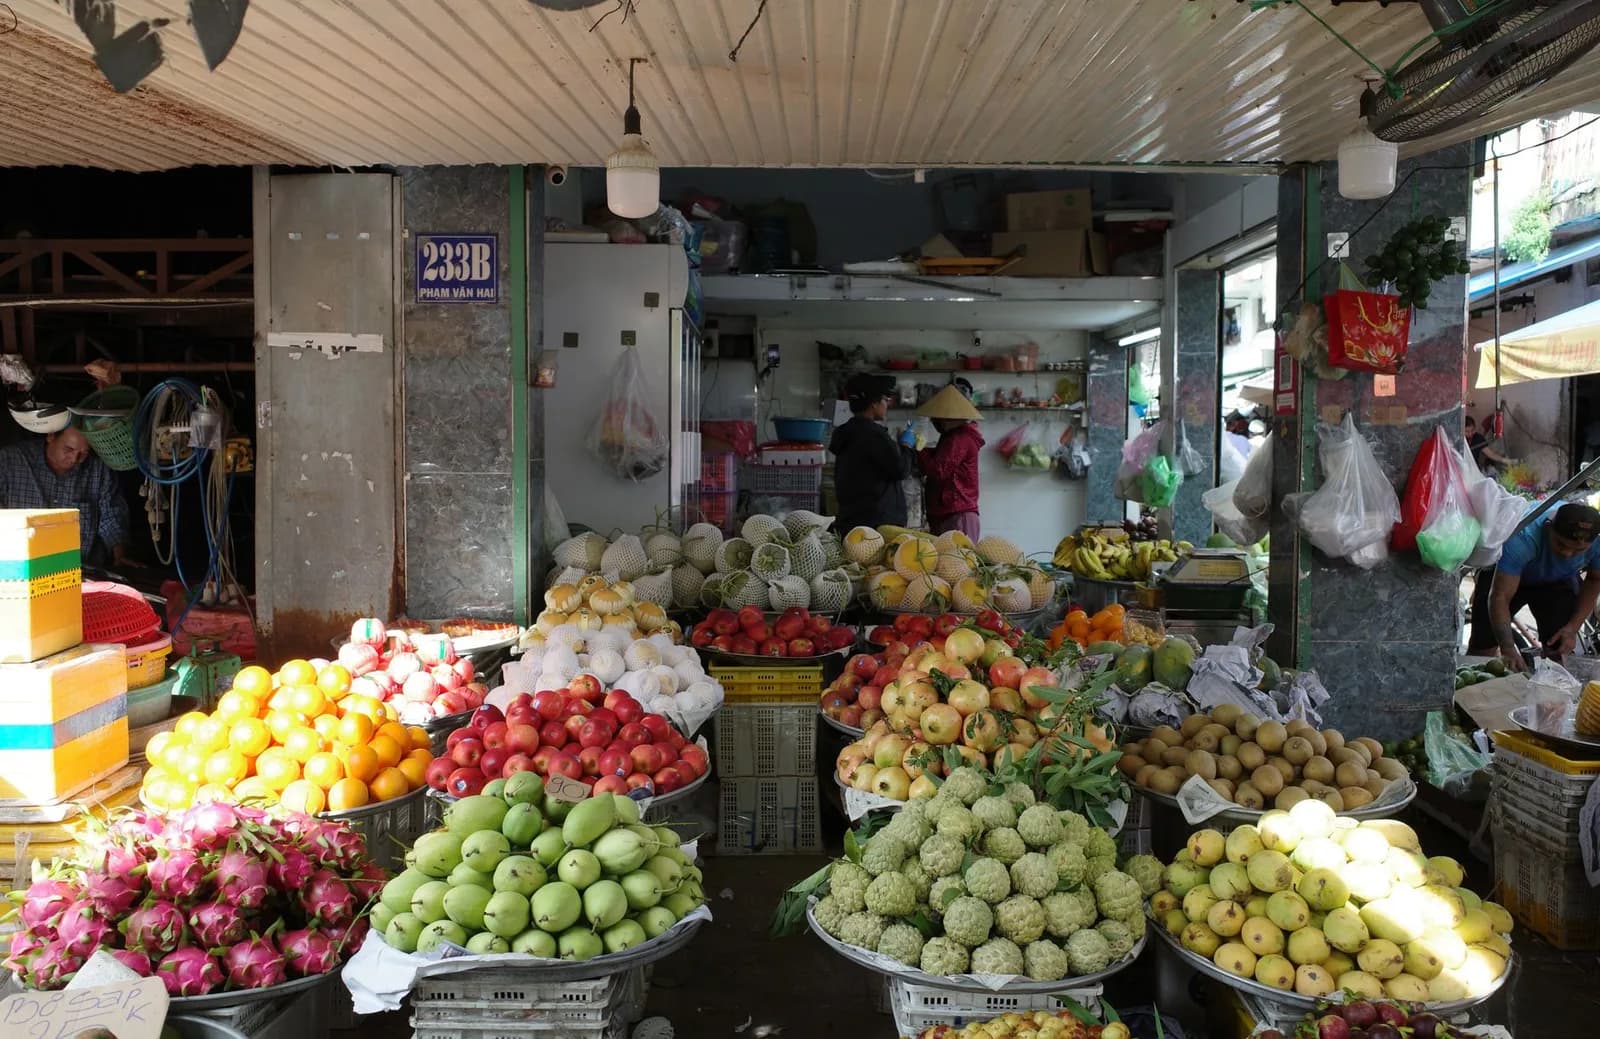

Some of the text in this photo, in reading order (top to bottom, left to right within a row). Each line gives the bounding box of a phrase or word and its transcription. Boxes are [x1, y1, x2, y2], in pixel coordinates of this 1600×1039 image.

[423, 241, 491, 281] 233B
[420, 286, 494, 300] PHẠM VĂN HAI
[551, 777, 585, 799] 90
[126, 1002, 152, 1022] K
